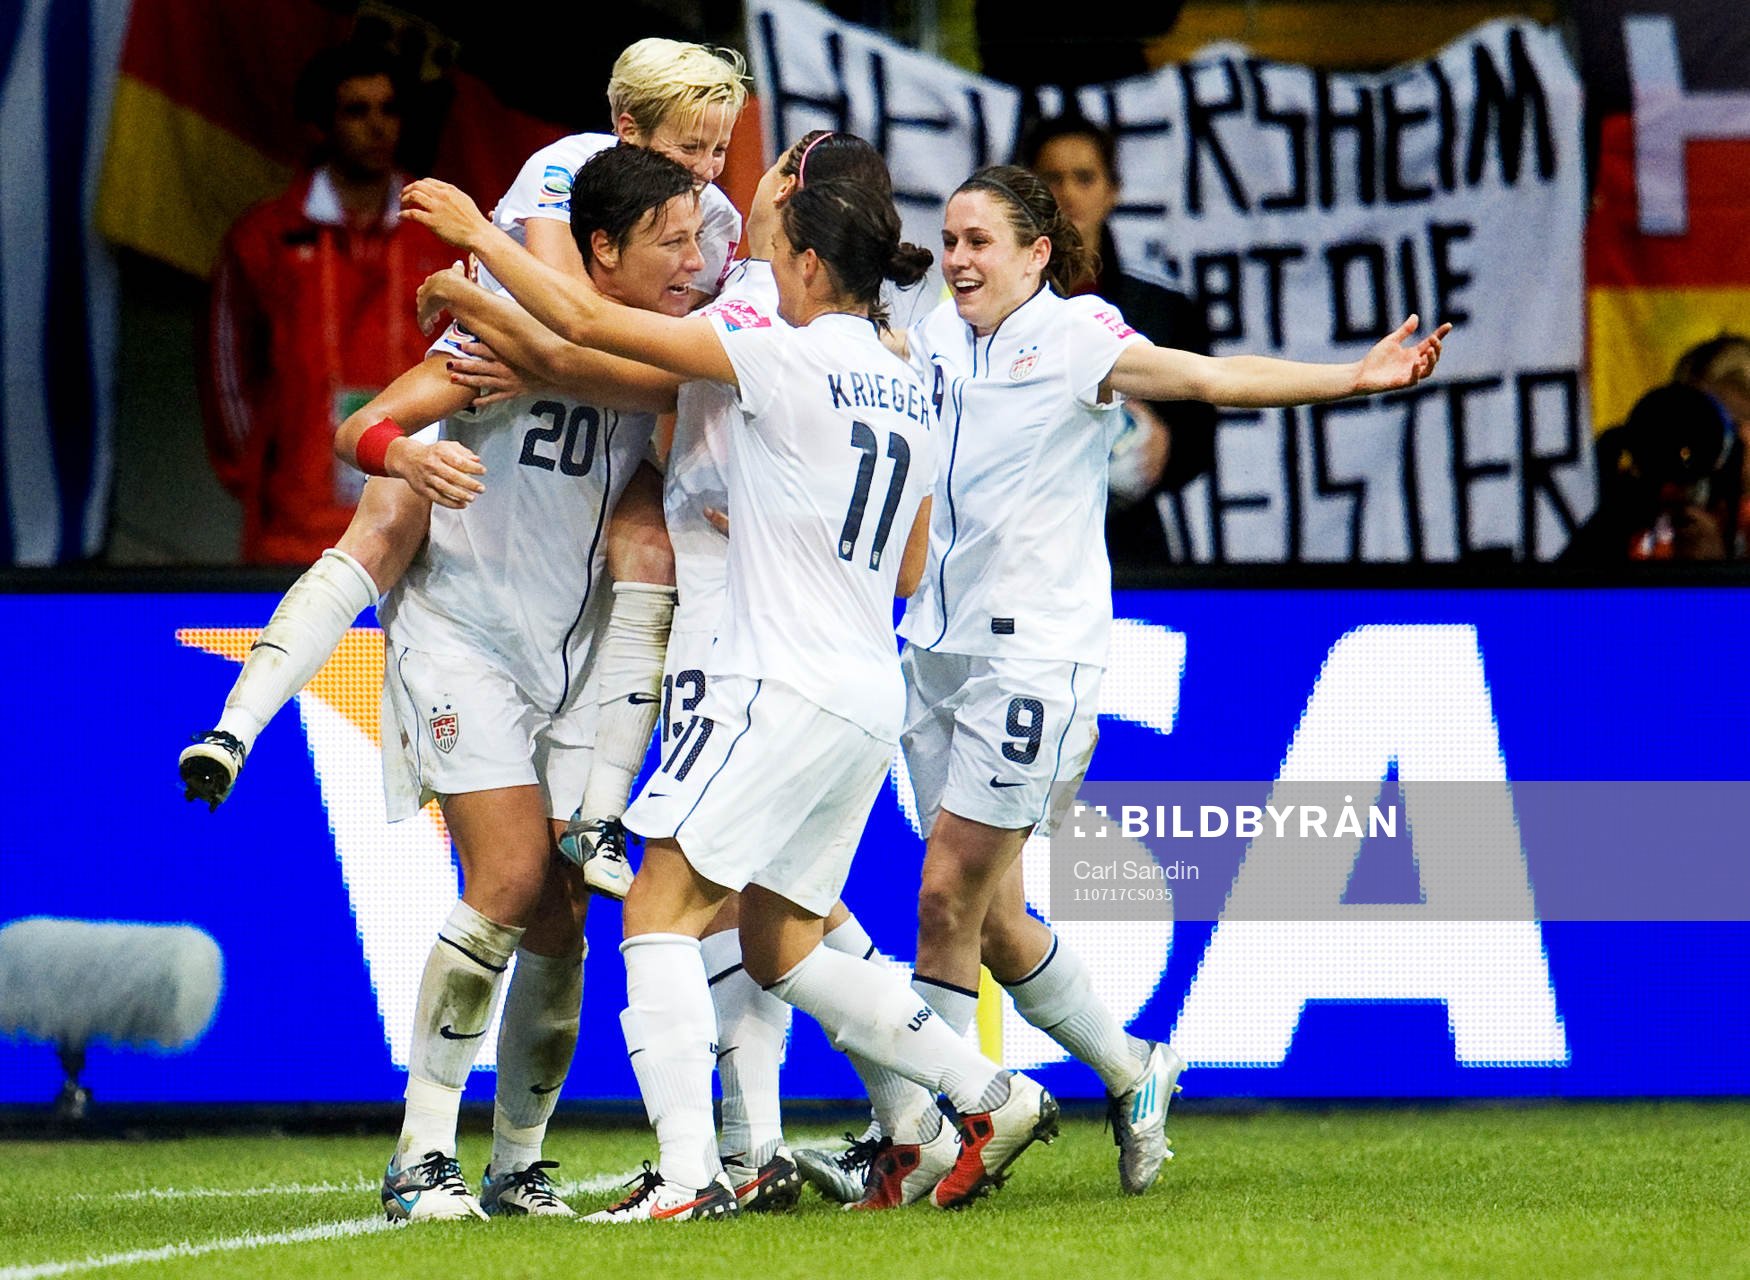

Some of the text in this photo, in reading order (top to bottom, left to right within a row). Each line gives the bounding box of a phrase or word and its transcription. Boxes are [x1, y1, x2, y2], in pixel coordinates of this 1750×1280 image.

[1324, 220, 1475, 343] DIE
[519, 400, 600, 477] 20
[838, 420, 911, 572] 11
[663, 669, 706, 743] 13
[1001, 697, 1044, 765] 9
[661, 714, 714, 782] 11
